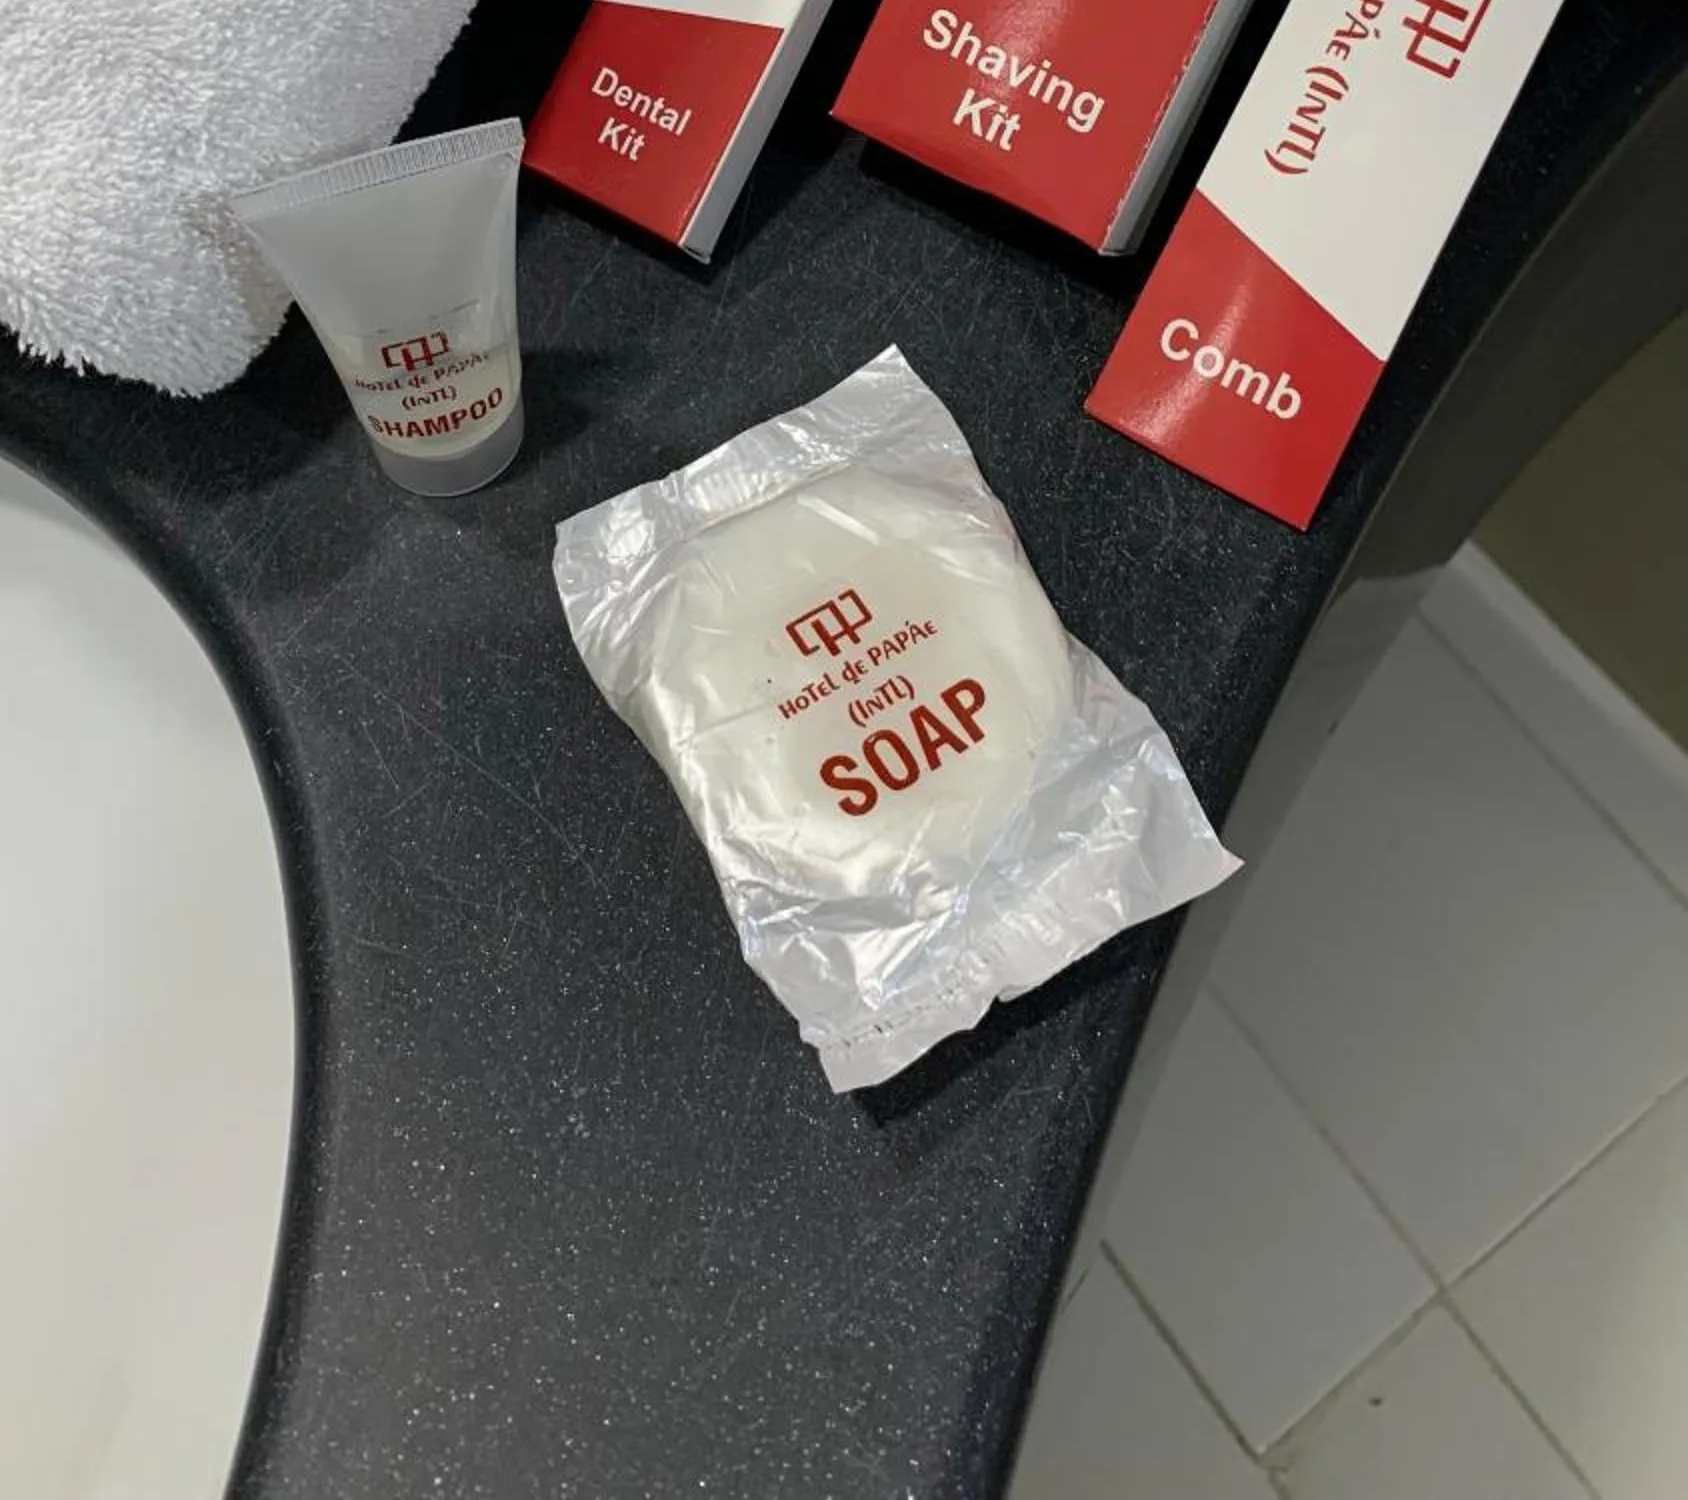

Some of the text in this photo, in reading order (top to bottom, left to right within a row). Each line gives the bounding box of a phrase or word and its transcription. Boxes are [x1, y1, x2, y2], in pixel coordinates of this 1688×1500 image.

[591, 67, 692, 137] Dental
[923, 9, 1105, 133] Shaving
[597, 116, 645, 161] Kit
[953, 88, 1021, 151] Kit
[1161, 318, 1302, 420] Comb
[368, 387, 504, 438] SHAMPOO
[841, 660, 869, 684] de
[819, 678, 987, 817] SOAP
